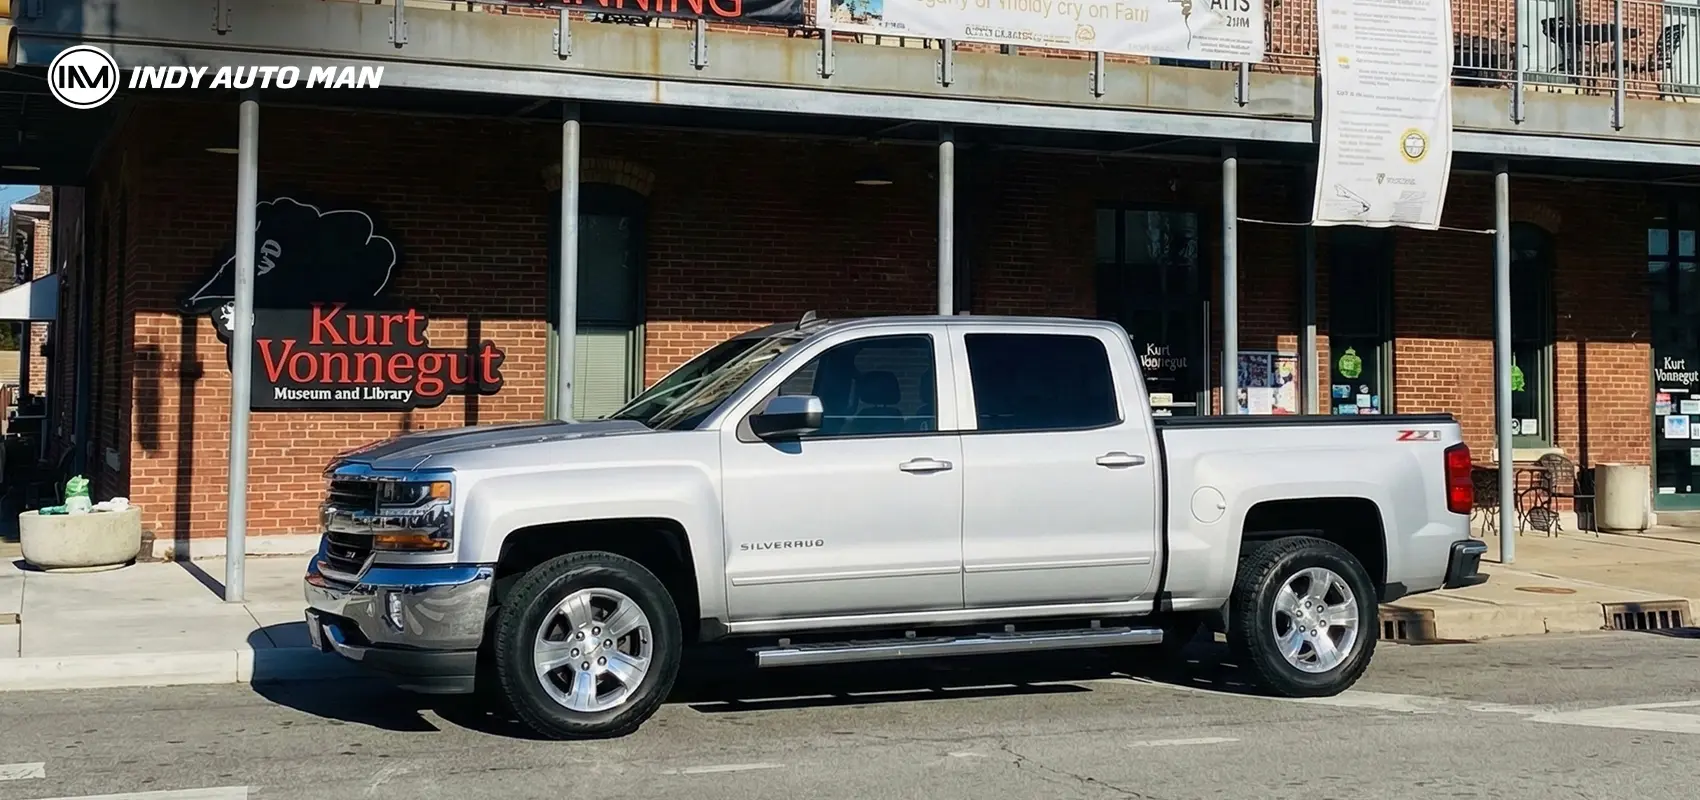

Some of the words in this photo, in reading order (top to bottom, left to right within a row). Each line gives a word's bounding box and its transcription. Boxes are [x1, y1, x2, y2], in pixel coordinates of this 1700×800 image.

[308, 302, 426, 347] Kurt
[256, 338, 501, 397] Vonnegut
[1663, 356, 1686, 370] Kurt
[1654, 368, 1700, 386] Vonnegut
[274, 387, 332, 400] Museum
[334, 387, 361, 401] and
[364, 387, 413, 403] Library
